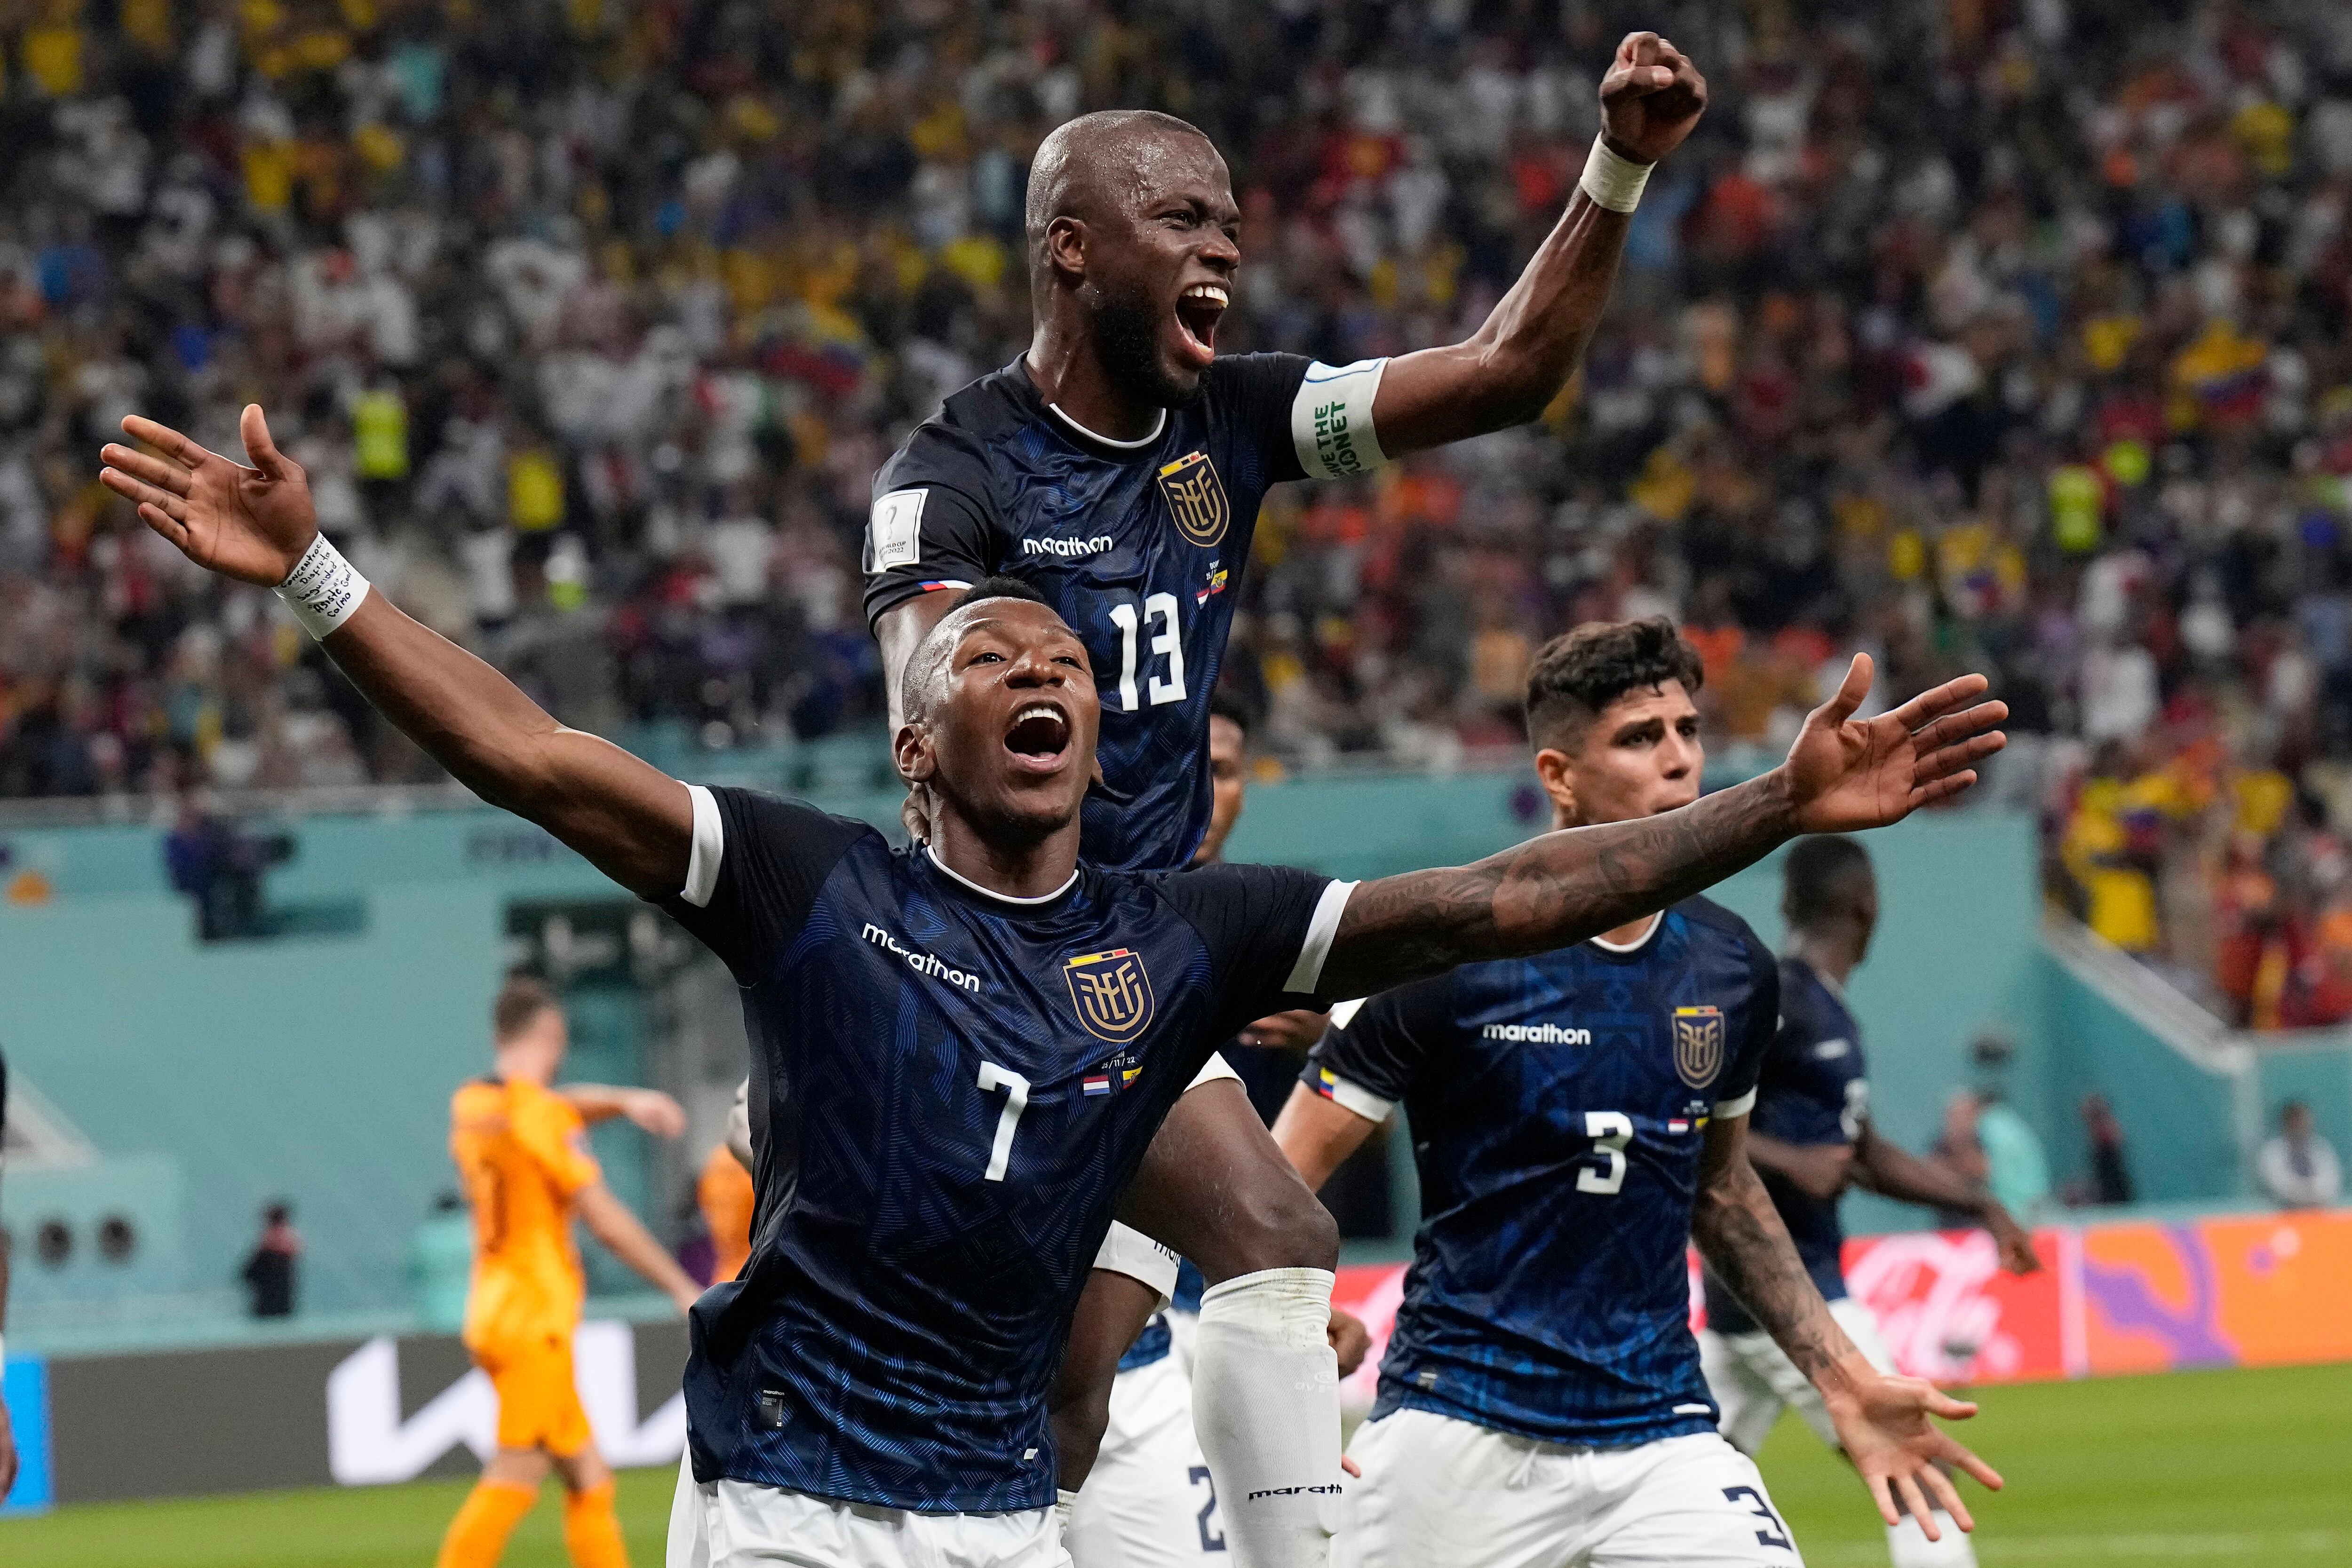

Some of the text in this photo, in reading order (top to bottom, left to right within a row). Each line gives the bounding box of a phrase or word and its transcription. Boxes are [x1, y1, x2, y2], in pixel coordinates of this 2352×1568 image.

[1315, 404, 1331, 450] THE
[1023, 534, 1113, 556] marathon
[1108, 592, 1187, 712] 13
[862, 921, 980, 993] marathon
[1483, 1023, 1591, 1046] marathon
[976, 1060, 1031, 1181] 7
[1576, 1111, 1634, 1195] 3
[1188, 1465, 1226, 1552] 2
[1722, 1485, 1793, 1552] 3
